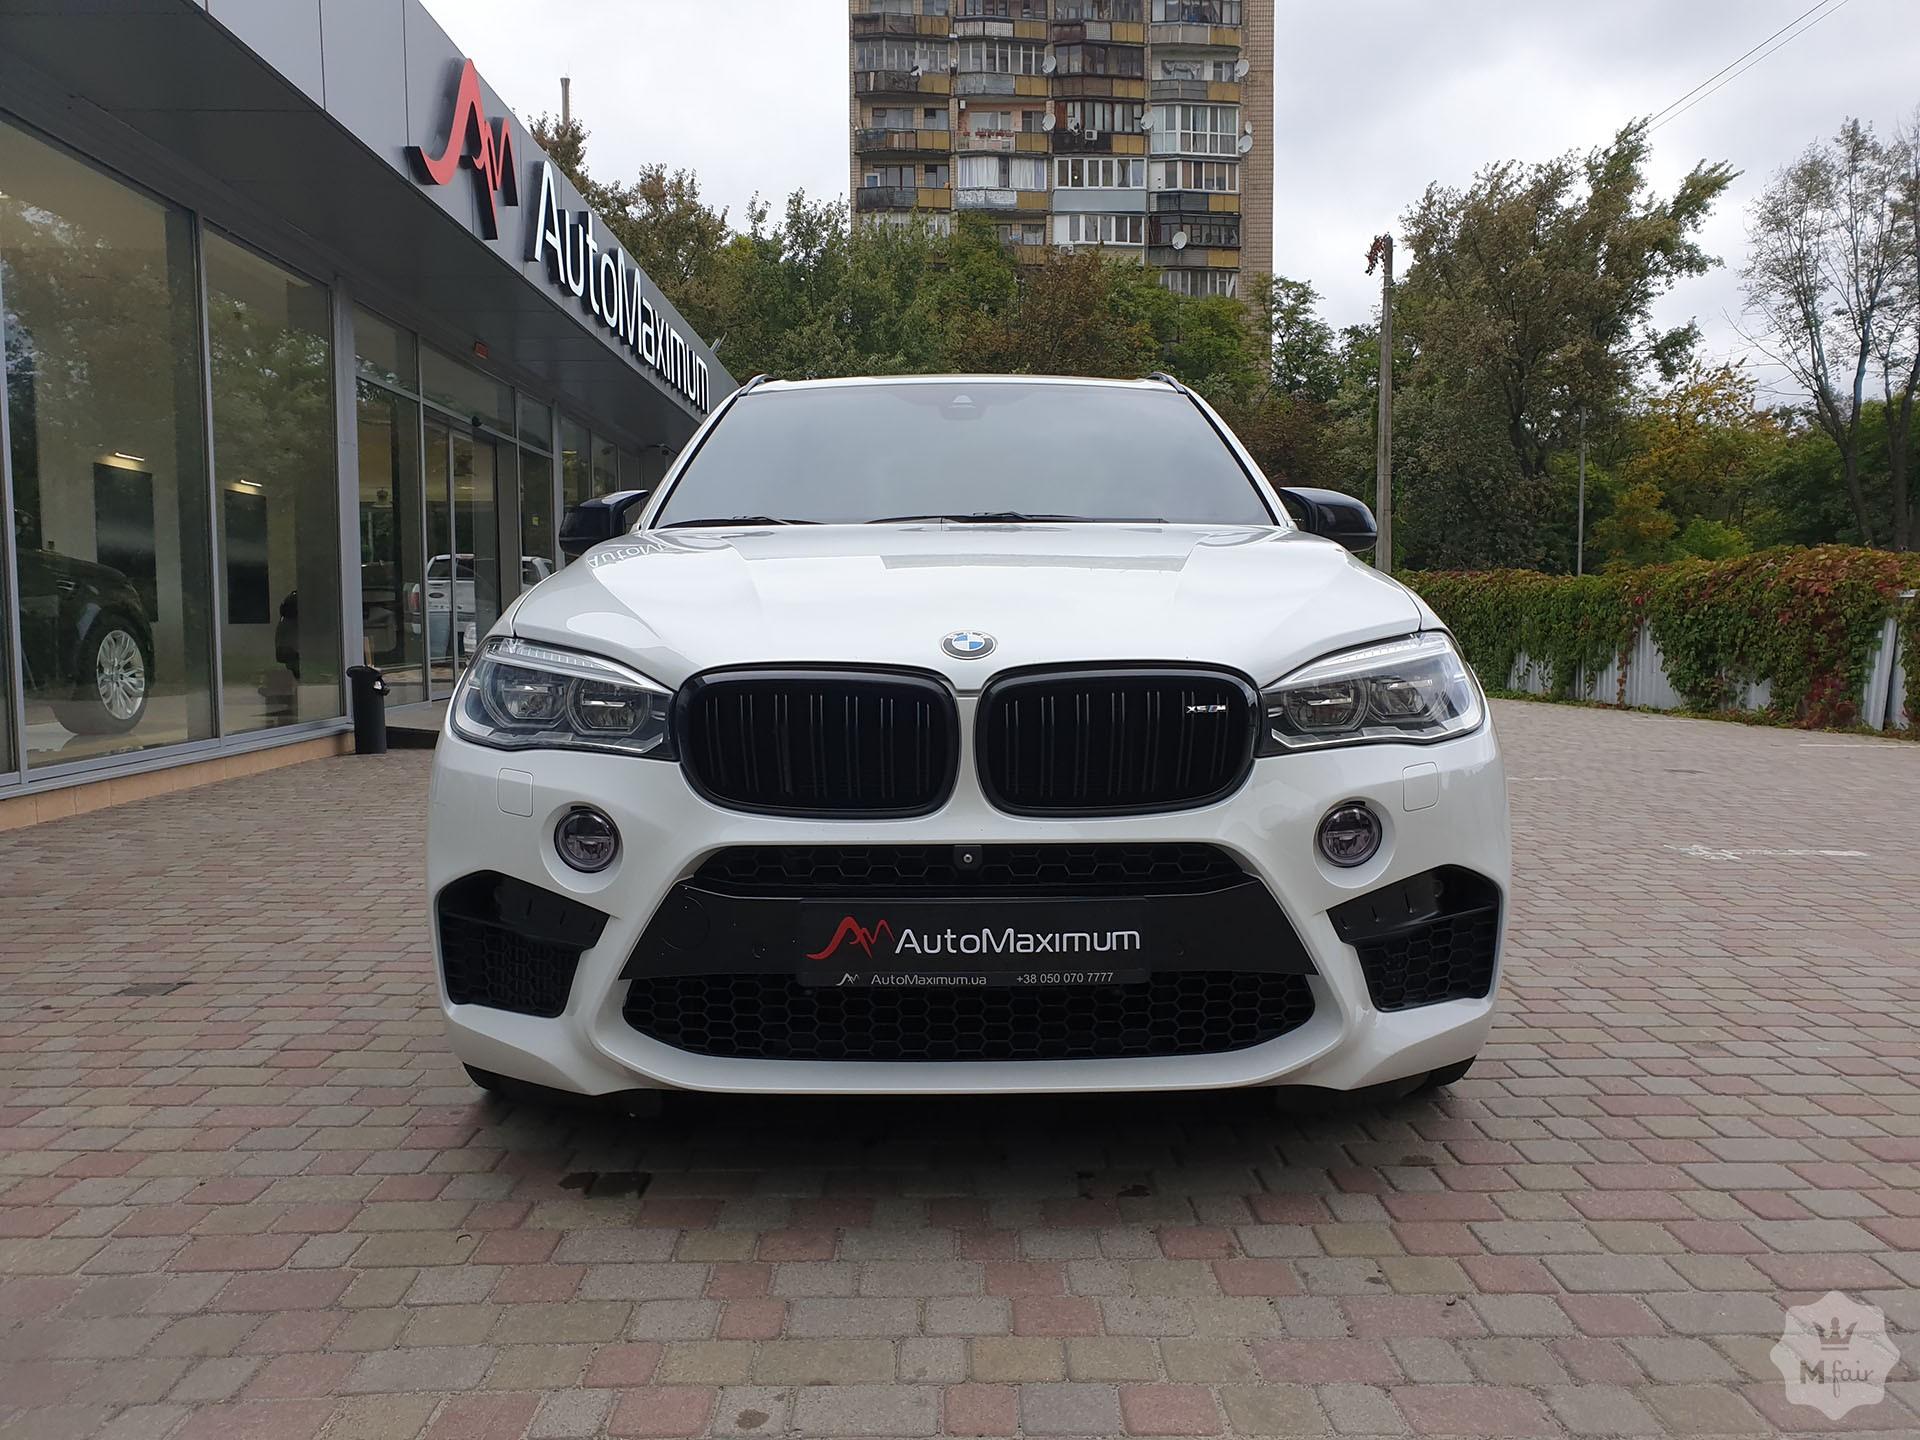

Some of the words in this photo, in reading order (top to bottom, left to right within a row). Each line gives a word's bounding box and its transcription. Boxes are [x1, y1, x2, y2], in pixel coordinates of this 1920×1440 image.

[526, 160, 711, 415] AutoMaximum
[895, 927, 1141, 955] AutoMaximum
[870, 973, 988, 986] AutoMaximum.ua
[1016, 973, 1038, 985] +38
[1040, 973, 1060, 984] 050
[1063, 973, 1084, 983] 070
[1087, 972, 1114, 983] 7777
